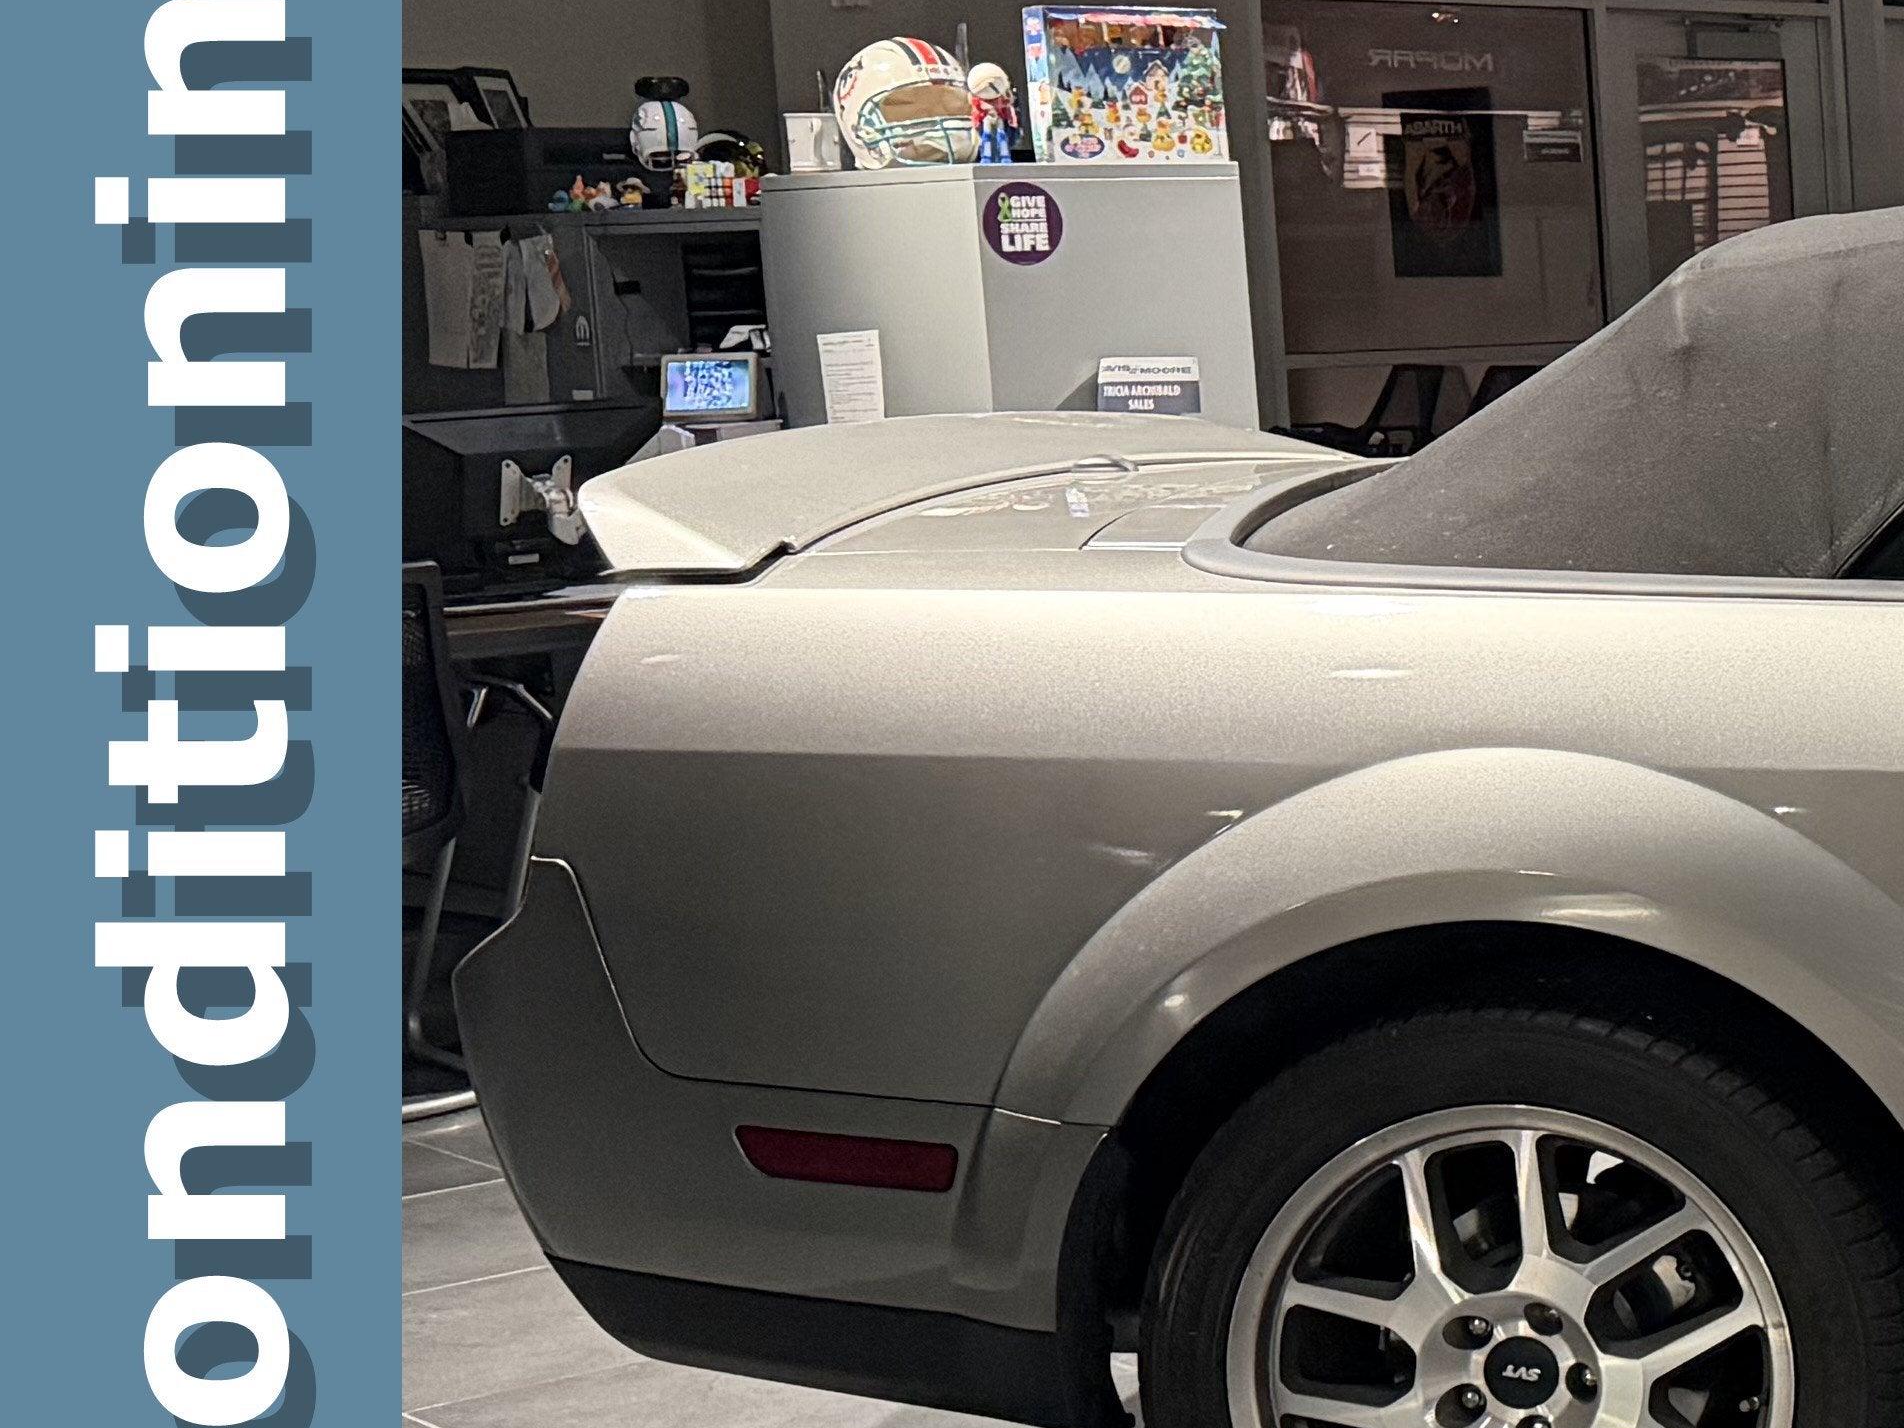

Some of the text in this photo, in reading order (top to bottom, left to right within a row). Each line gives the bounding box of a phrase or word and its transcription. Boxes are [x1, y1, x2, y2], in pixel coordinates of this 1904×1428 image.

[1010, 195, 1046, 208] GIVE
[1011, 208, 1047, 219] HOPE
[1000, 222, 1049, 234] SHARE
[1001, 234, 1050, 252] LIFE
[1128, 398, 1155, 410] SALES
[1501, 1364, 1542, 1383] SVT
